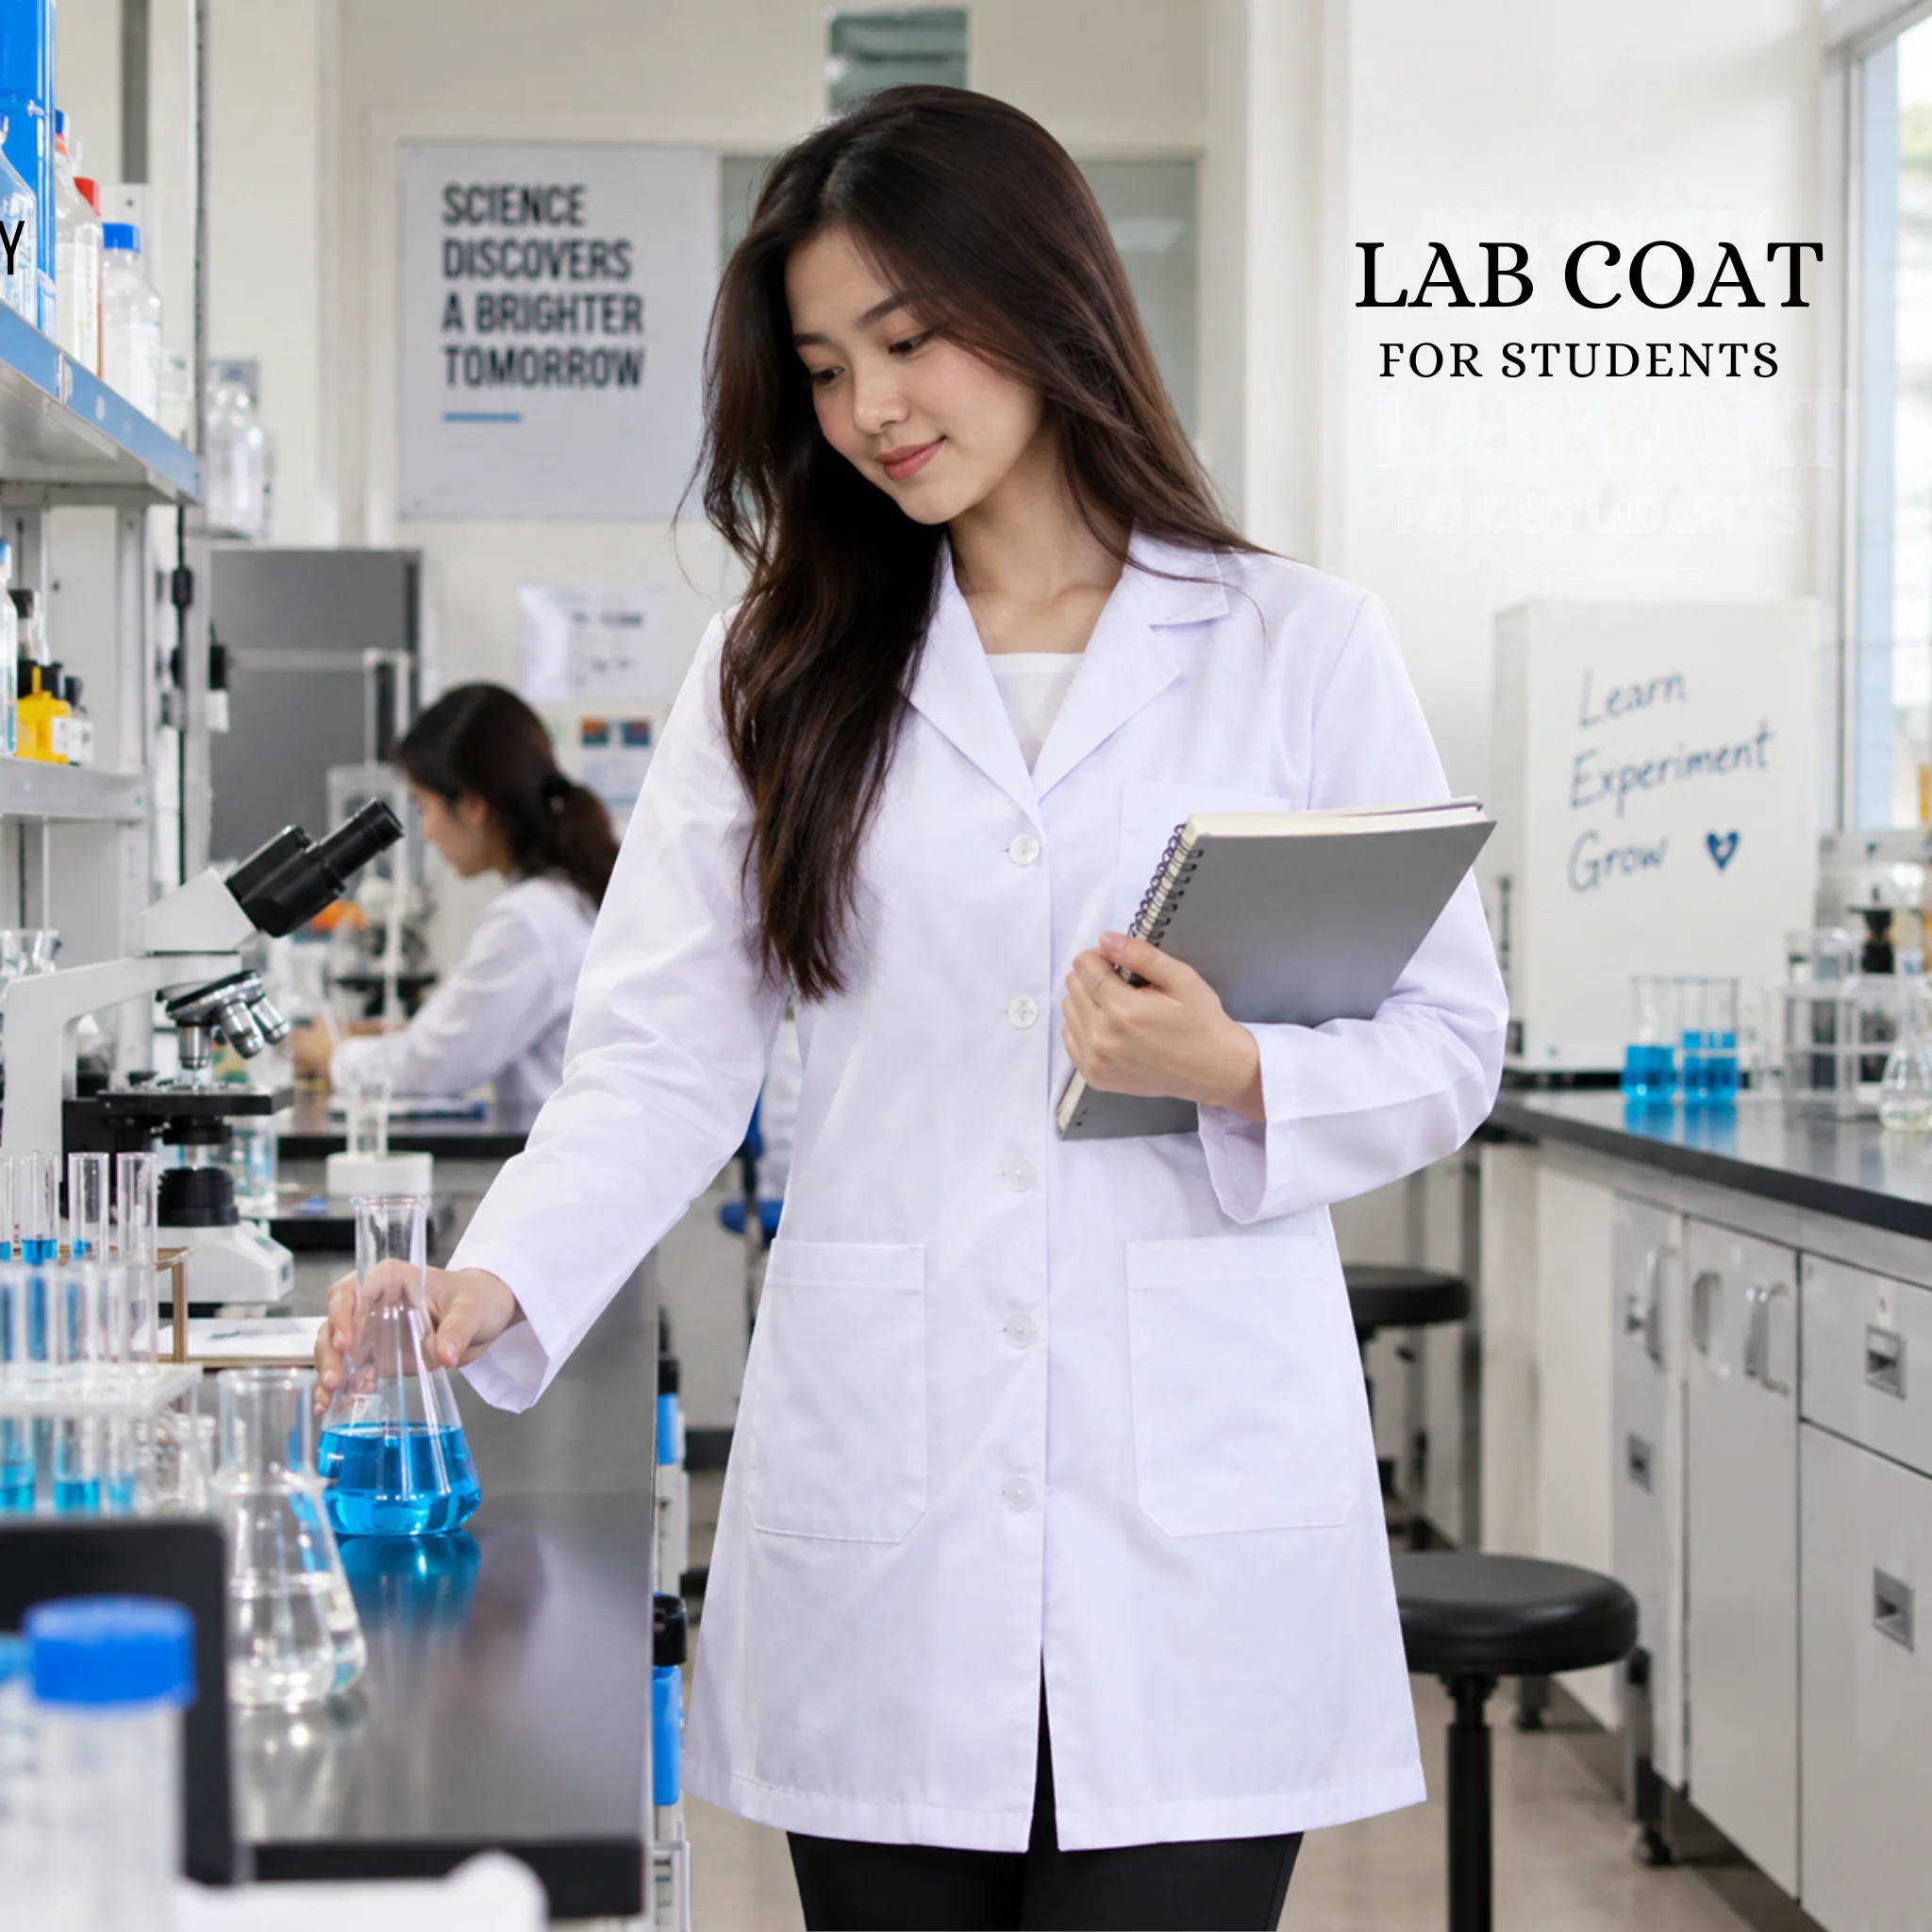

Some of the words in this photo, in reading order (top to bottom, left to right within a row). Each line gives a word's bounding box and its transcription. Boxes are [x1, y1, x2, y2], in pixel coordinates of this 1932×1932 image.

[441, 183, 587, 227] SCIENCE
[442, 238, 633, 281] DISCOVERS
[441, 291, 465, 334] A
[475, 291, 644, 334] BRIGHTER
[441, 344, 645, 389] TOMORROW
[1579, 668, 1687, 729] Learn
[1569, 719, 1775, 819] Experiment
[1567, 828, 1669, 892] Grow
